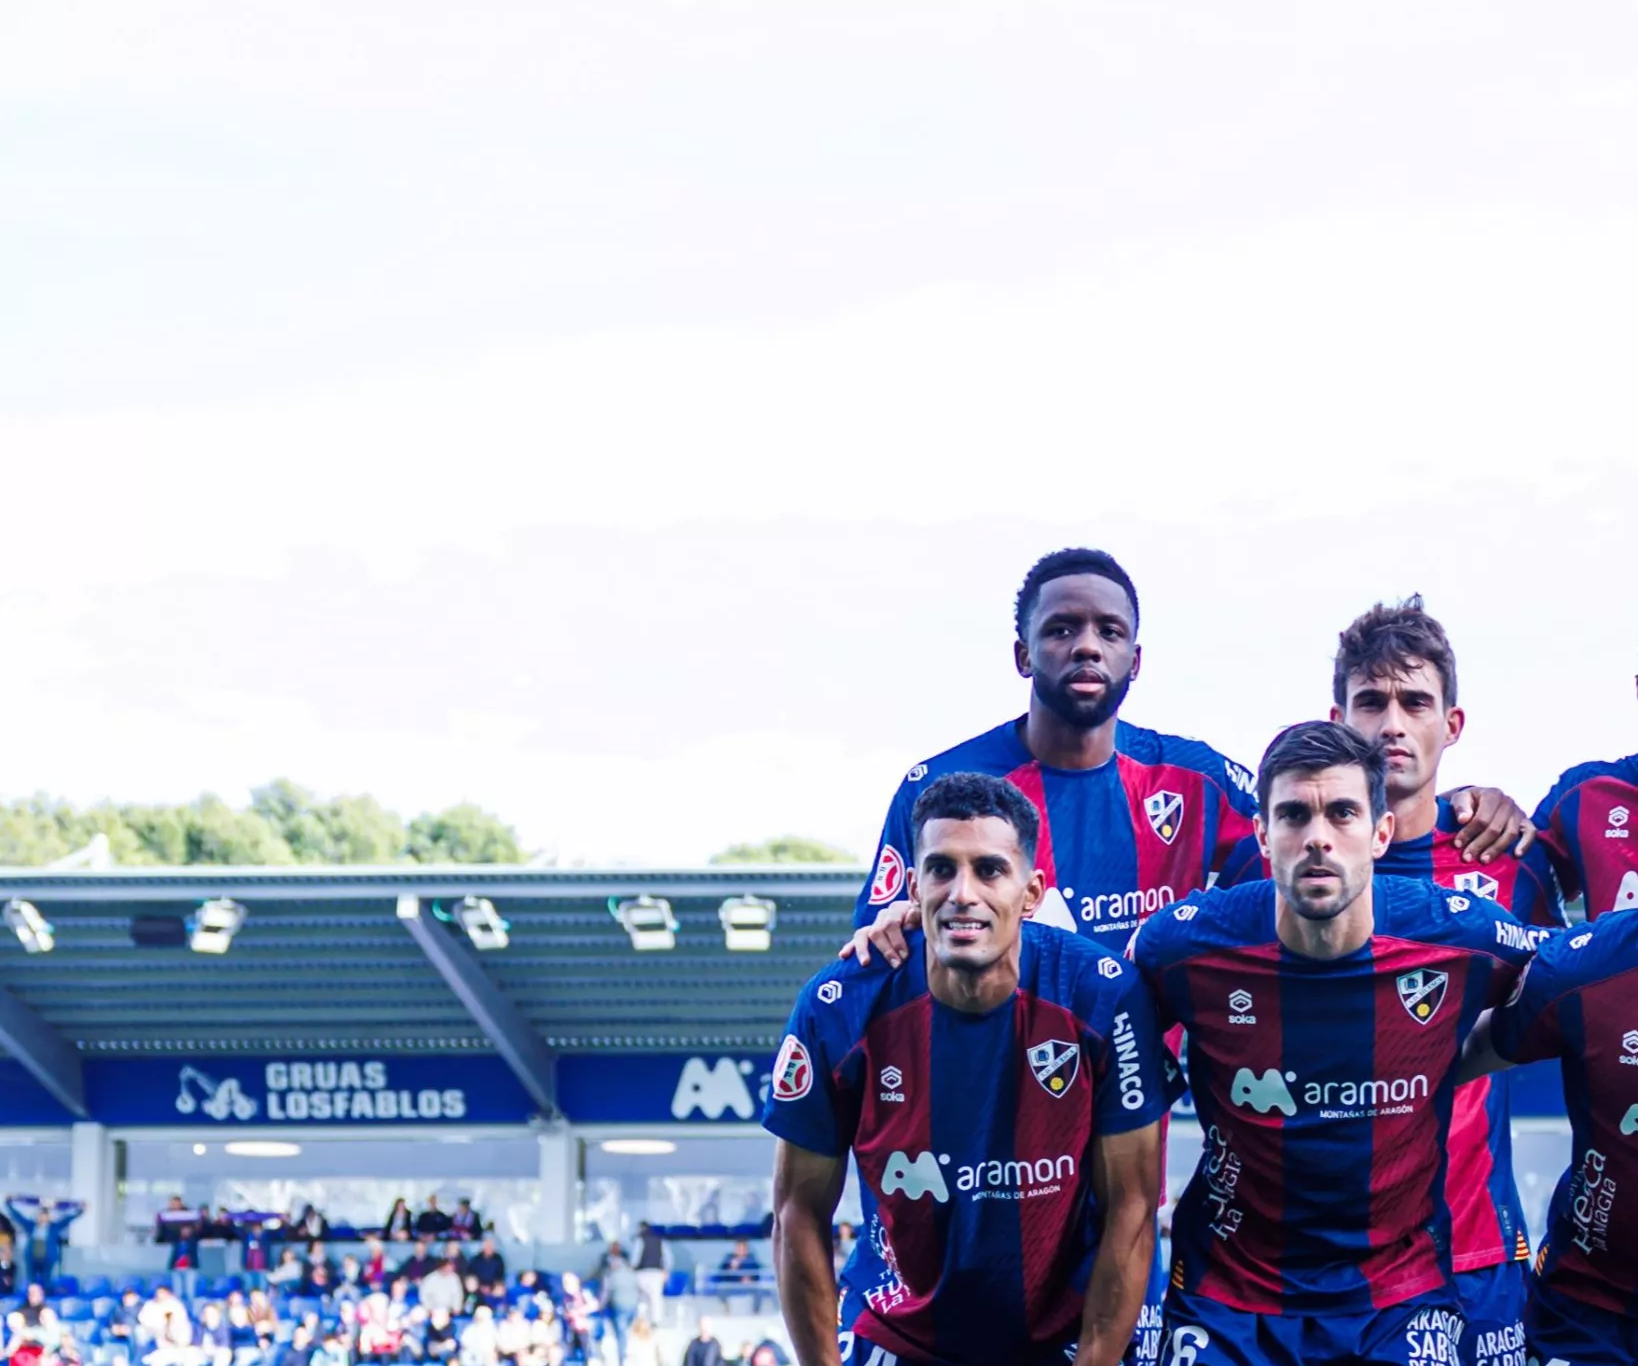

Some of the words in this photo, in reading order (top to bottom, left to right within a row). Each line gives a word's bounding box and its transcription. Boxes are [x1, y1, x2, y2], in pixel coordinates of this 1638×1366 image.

[1080, 885, 1175, 922] aramon
[265, 1062, 387, 1091] GRUAS
[1304, 1074, 1428, 1105] aramon
[266, 1089, 466, 1120] LOSFABLOS
[956, 1154, 1075, 1191] aramon
